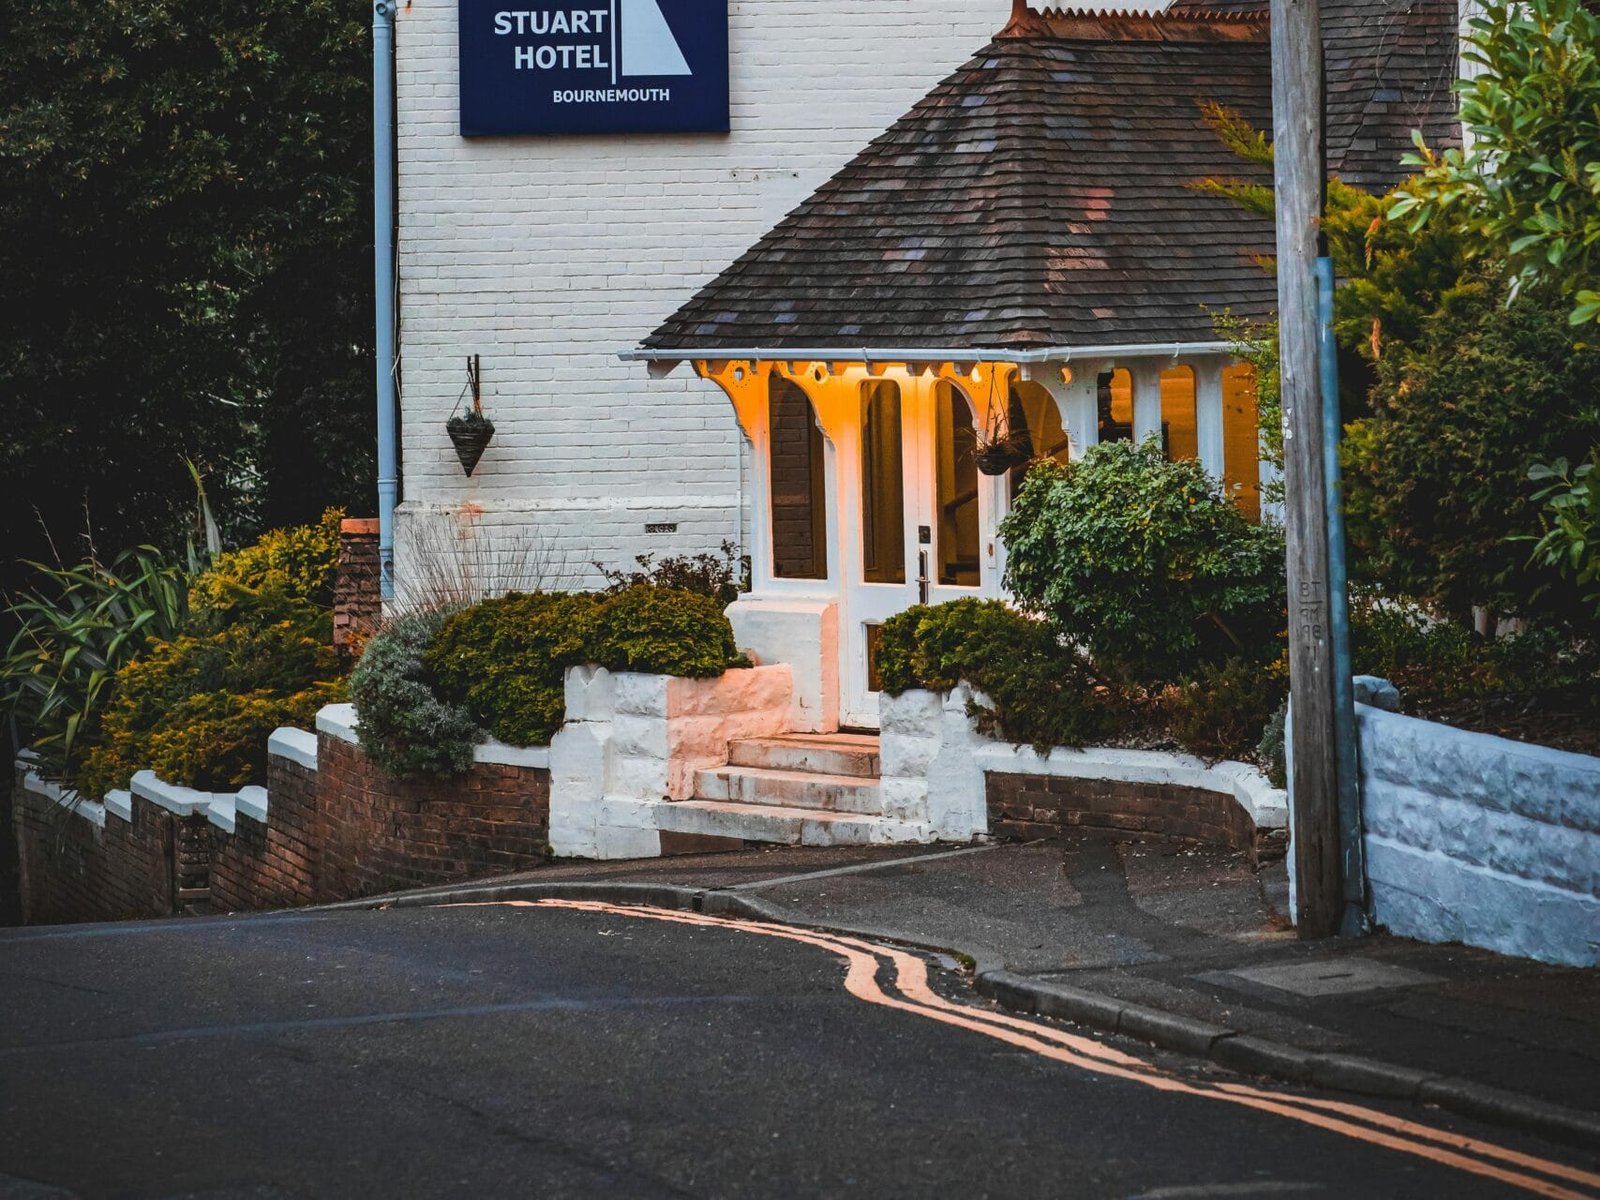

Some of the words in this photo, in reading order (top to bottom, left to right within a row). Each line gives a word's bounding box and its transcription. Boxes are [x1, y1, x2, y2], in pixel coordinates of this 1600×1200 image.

[494, 9, 608, 35] STUART
[514, 44, 609, 70] HOTEL
[553, 88, 670, 103] BOURNEMOUTH
